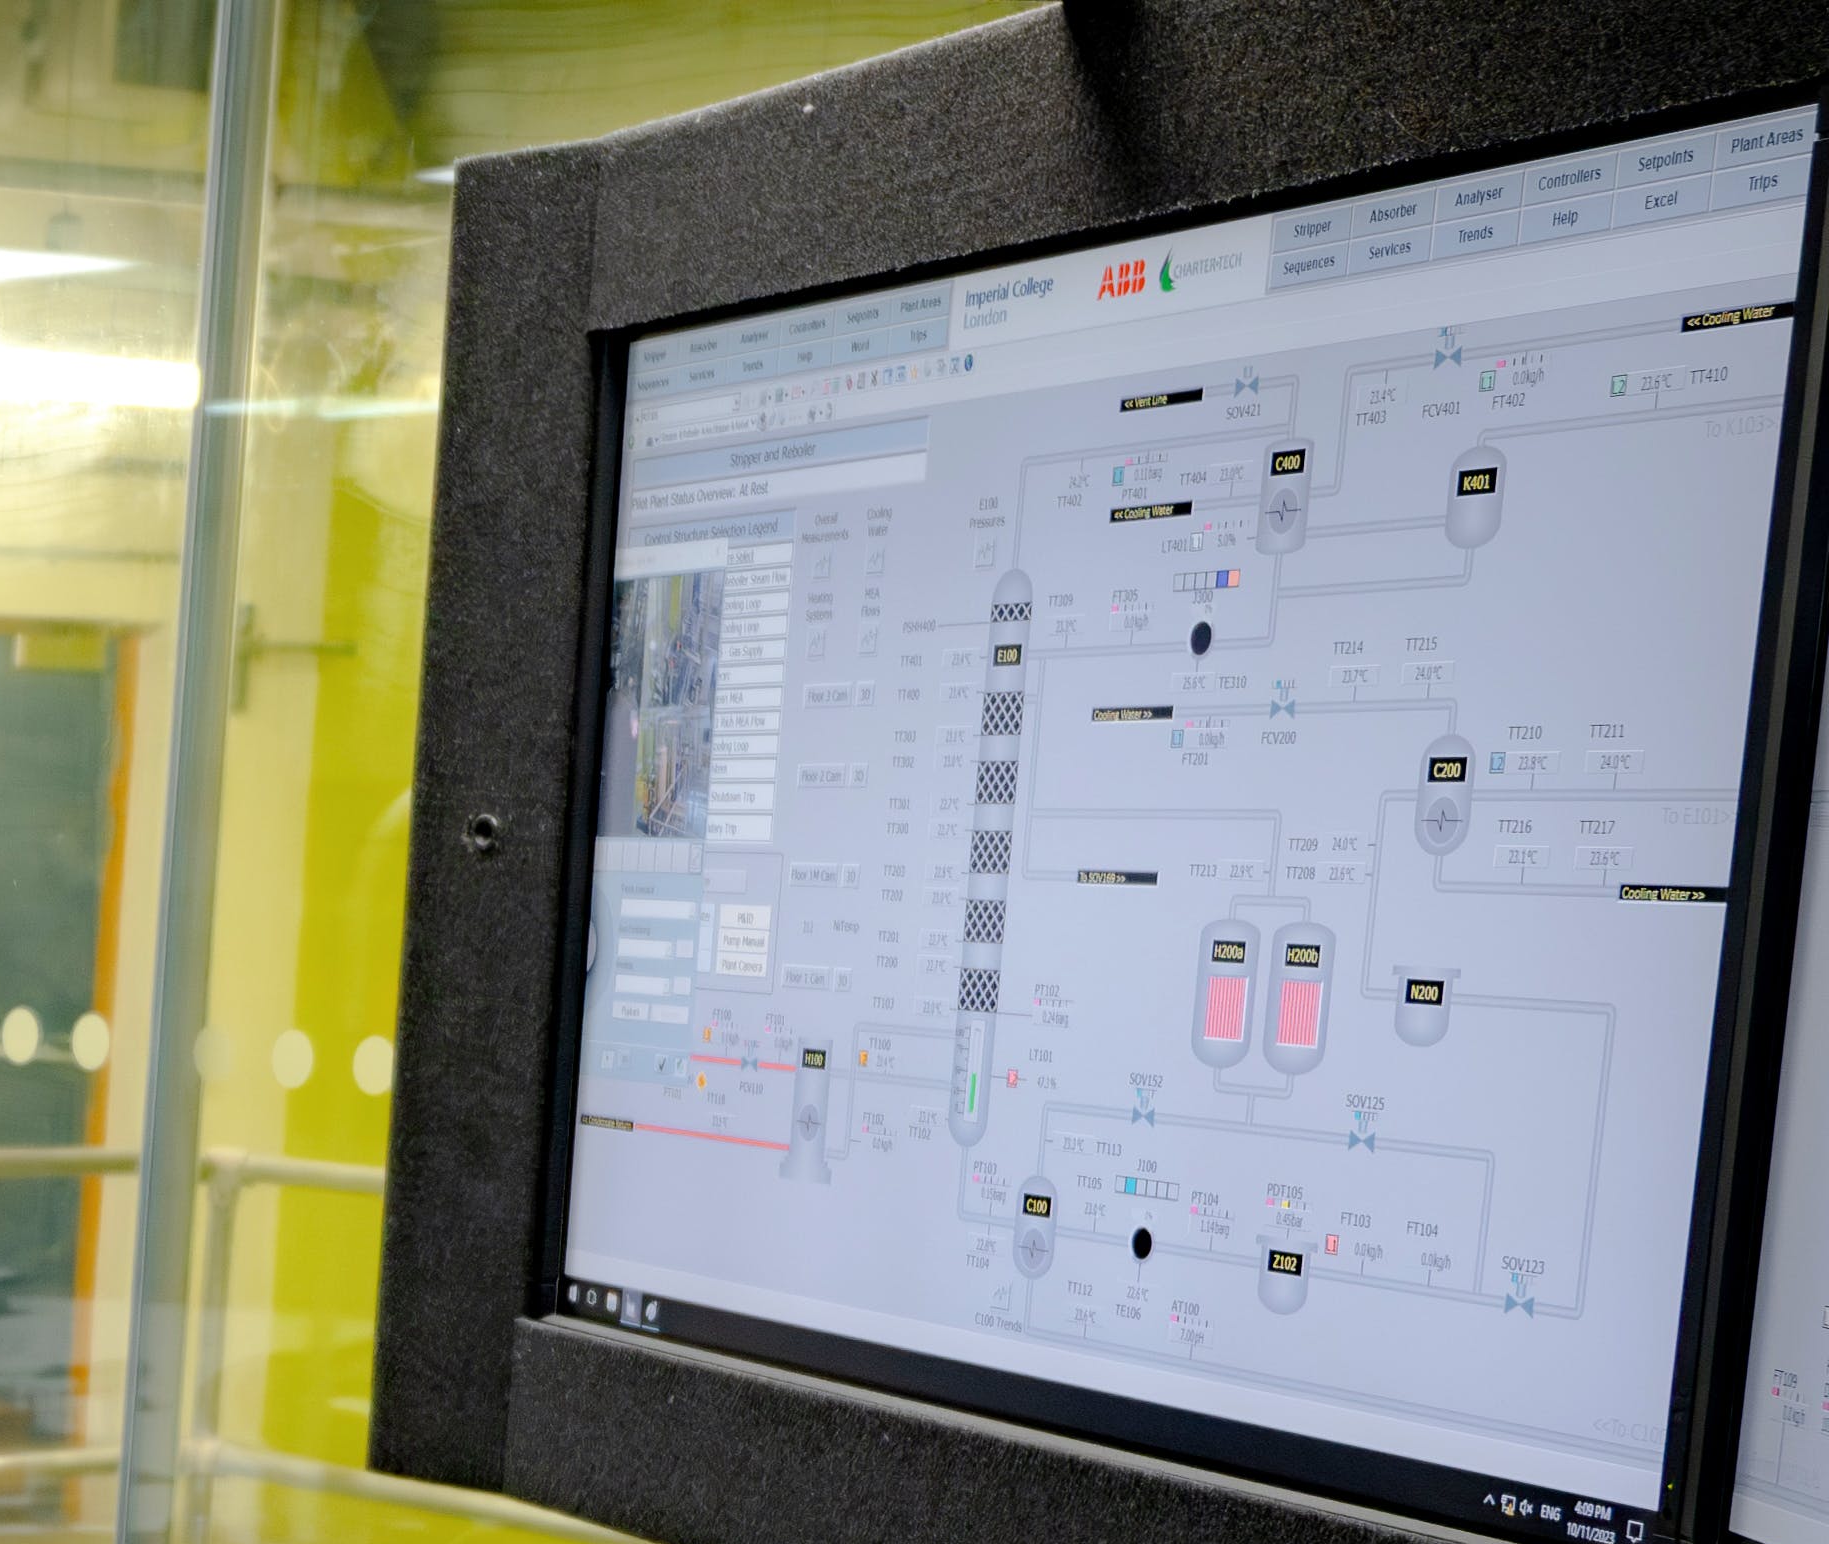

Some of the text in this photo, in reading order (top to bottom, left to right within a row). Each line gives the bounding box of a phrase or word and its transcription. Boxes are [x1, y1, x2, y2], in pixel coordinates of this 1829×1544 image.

[1731, 128, 1803, 153] Plant Areas
[1638, 148, 1694, 172] Setpoints
[1539, 167, 1601, 192] Controllers
[1748, 173, 1778, 191] Trips
[1455, 185, 1504, 207] Analyser
[1645, 191, 1678, 210] Excel
[1370, 203, 1417, 224] Absorber
[1553, 209, 1578, 226] Help
[1294, 219, 1332, 239] Stripper
[1459, 225, 1493, 244] Trends
[1369, 241, 1411, 260] Services
[1283, 255, 1335, 275] Sequences
[1097, 259, 1146, 300] ABB
[965, 276, 1054, 309] Imperial College
[963, 308, 1007, 330] London
[1702, 310, 1741, 327] Cooling
[1743, 305, 1775, 320] Water
[1690, 366, 1728, 385] TT410
[1492, 393, 1525, 409] FT402
[1226, 403, 1261, 420] SOV421
[1356, 411, 1386, 426] TT403
[1422, 402, 1460, 419] FCV401
[1275, 456, 1301, 472] C400
[1463, 474, 1490, 491] K401
[1124, 506, 1151, 520] Cooling
[1152, 503, 1174, 516] Water
[1333, 640, 1363, 655] TT214
[1405, 636, 1438, 652] TT215
[997, 649, 1018, 663] E100
[1093, 709, 1119, 722] Cooling
[1120, 708, 1142, 720] Water
[1261, 731, 1297, 745] FCV200
[1508, 725, 1542, 740] TT210
[1590, 724, 1624, 738] TT211
[1182, 752, 1209, 766] FT201
[1433, 762, 1461, 778] C200
[1498, 819, 1532, 834] TT216
[1580, 819, 1615, 835] TT217
[1289, 838, 1319, 852] TT209
[1189, 864, 1217, 878] TT213
[1286, 866, 1316, 880] TT208
[1621, 886, 1658, 901] Cooling
[1660, 888, 1690, 901] Water
[1214, 943, 1244, 960] H200a
[1287, 948, 1319, 964] H200b
[1411, 984, 1439, 1001] N200
[804, 1052, 823, 1066] H100
[1129, 1072, 1163, 1089] SOV152
[1345, 1094, 1385, 1111] SOV125
[1096, 1141, 1123, 1157] TT113
[1191, 1191, 1219, 1207] PT104
[1267, 1183, 1303, 1200] PDT105
[1026, 1198, 1048, 1214] C100
[1341, 1211, 1371, 1229] FT103
[1407, 1221, 1439, 1238] FT104
[1273, 1254, 1297, 1272] Z102
[1501, 1256, 1545, 1276] SOV123
[996, 1317, 1023, 1334] Trends
[1541, 1504, 1561, 1521] ENG
[1574, 1500, 1612, 1521] 4:09 PM
[1567, 1522, 1615, 1544] 10/11/2023
